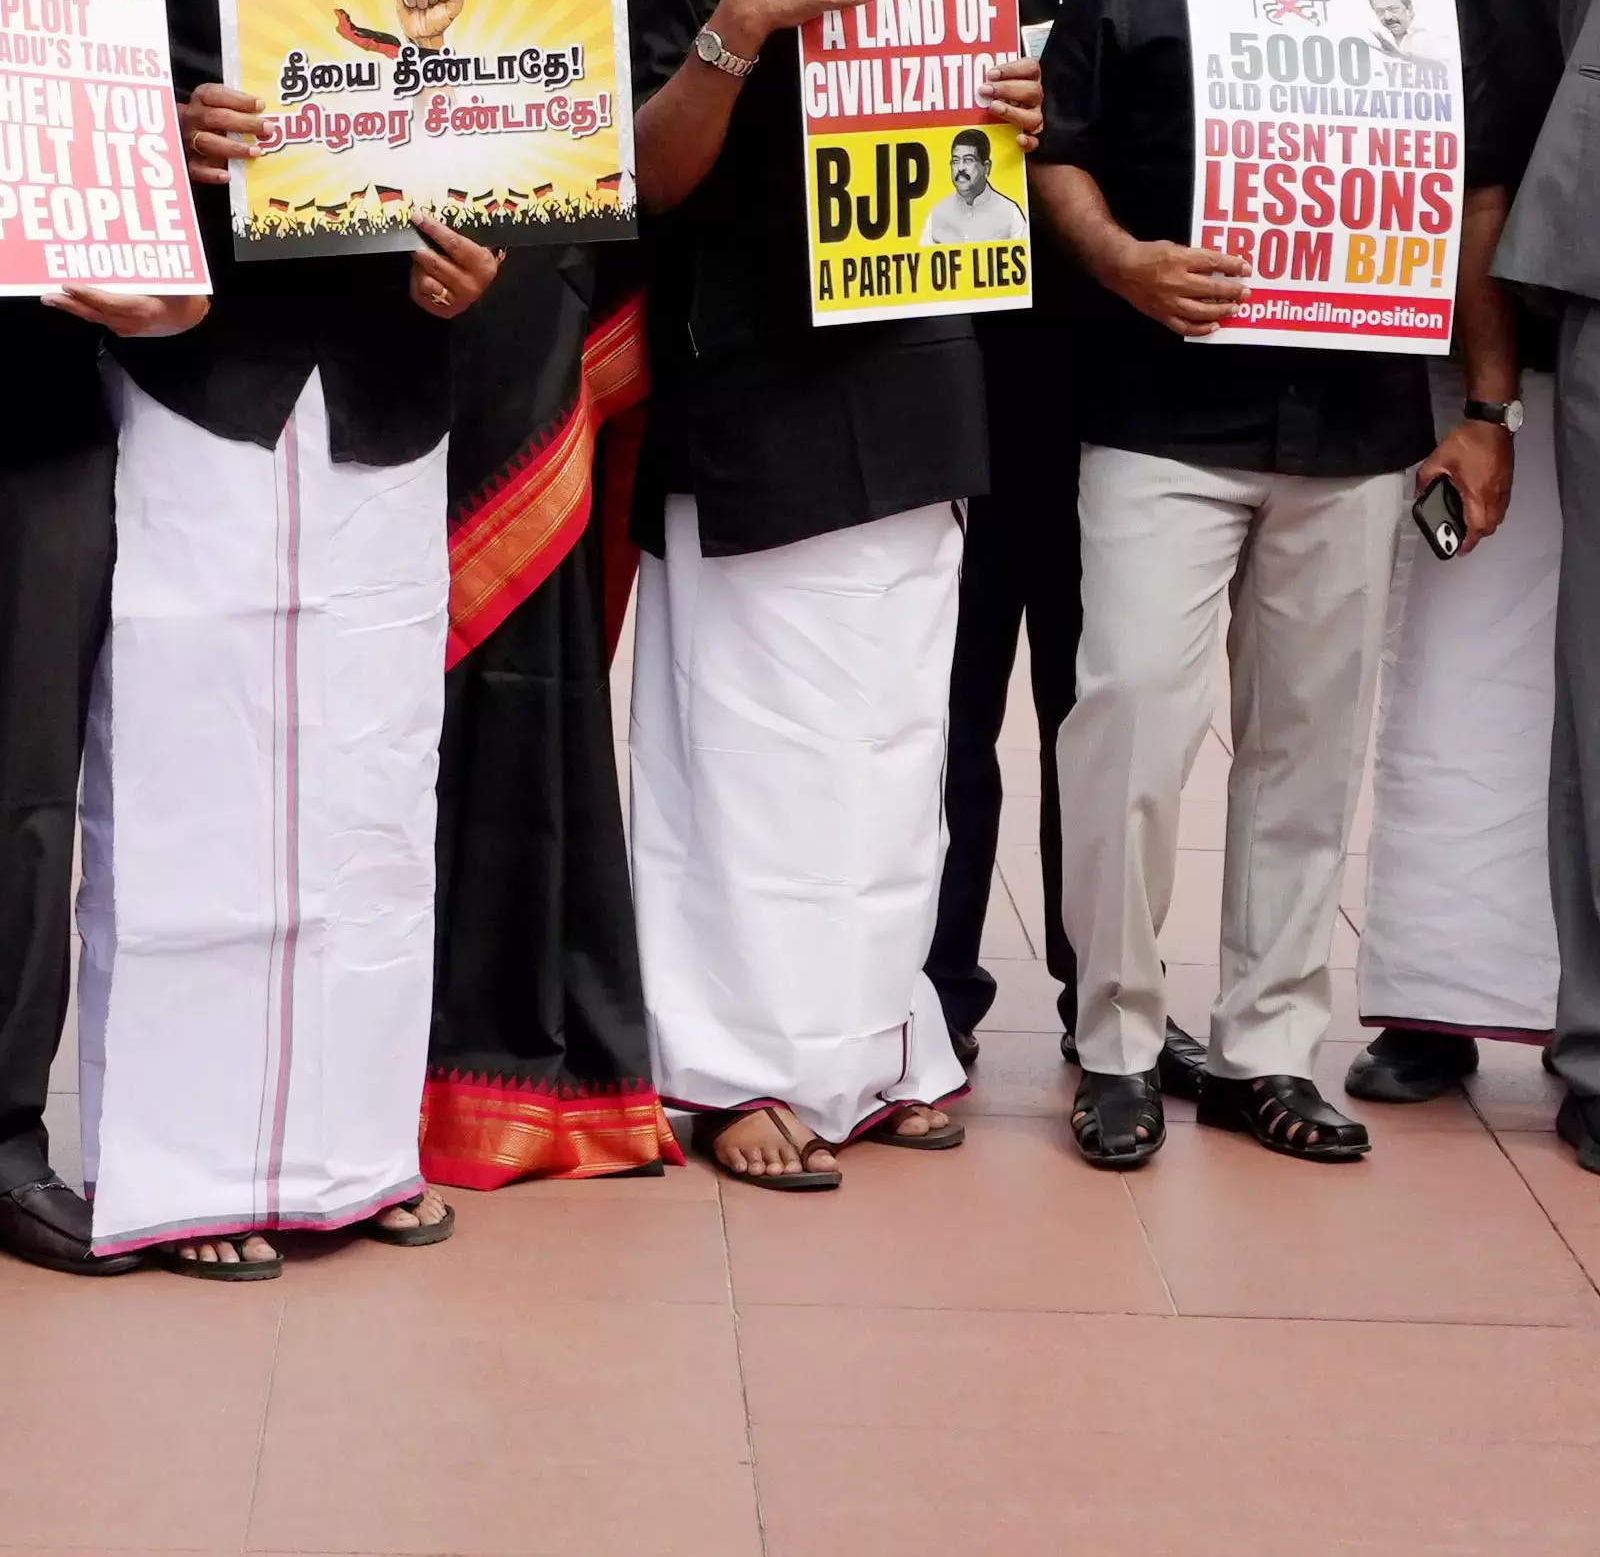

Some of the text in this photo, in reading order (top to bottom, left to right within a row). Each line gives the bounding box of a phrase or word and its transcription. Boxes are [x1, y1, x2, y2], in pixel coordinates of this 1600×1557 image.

[823, 9, 846, 50] A
[80, 43, 169, 80] TAXES,
[281, 46, 582, 100] தீயை தீண்டாதே!
[805, 51, 1018, 118] CIVILIZATIO
[1206, 53, 1224, 79] A
[84, 82, 165, 134] YOU
[425, 95, 609, 134] சீண்டாதே!
[1208, 81, 1452, 123] OLD CIVILIZATION
[92, 131, 174, 189] ITS
[1369, 127, 1458, 170] NEED
[816, 142, 930, 243] BJP
[1203, 159, 1453, 235] LESSONS
[44, 244, 194, 279] ENOUGH!
[819, 245, 1027, 301] A PARTY OF LIES
[1345, 232, 1447, 288] BJP!
[1232, 297, 1443, 330] opHindiImposition
